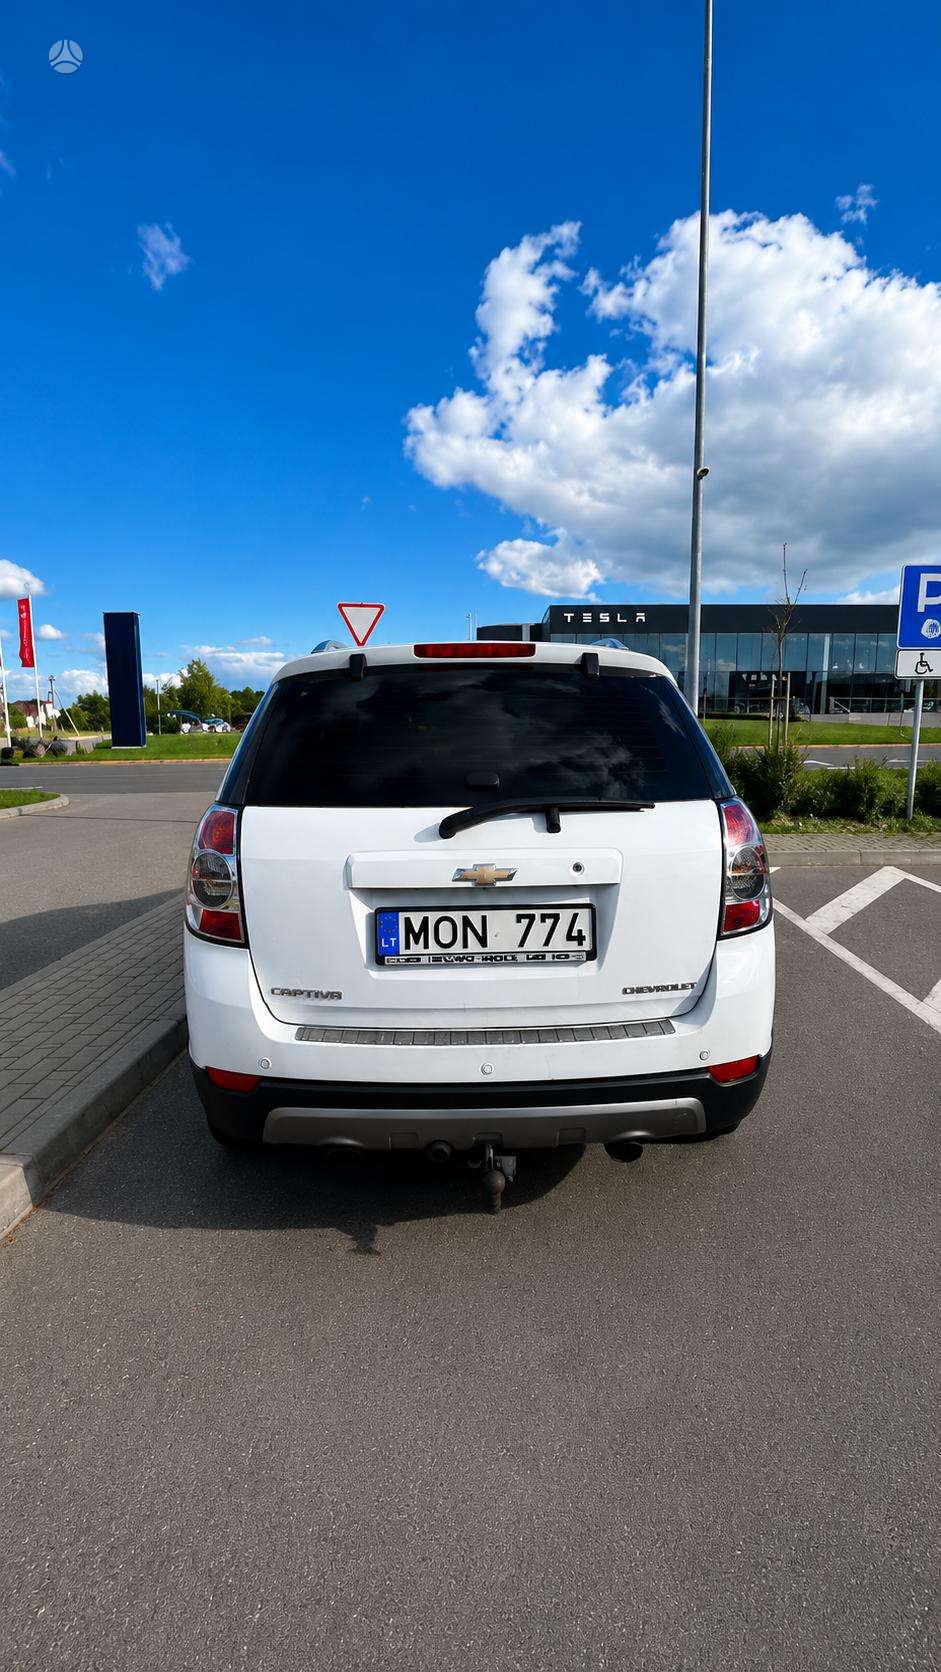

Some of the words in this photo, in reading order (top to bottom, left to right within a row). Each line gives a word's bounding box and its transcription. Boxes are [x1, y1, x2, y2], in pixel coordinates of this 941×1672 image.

[917, 573, 941, 612] P
[563, 613, 646, 623] TESLA
[404, 915, 488, 950] MON
[515, 912, 587, 948] 774
[381, 937, 397, 948] LT
[271, 987, 343, 1000] CAPTIVA
[622, 982, 697, 995] CHEVROLET
